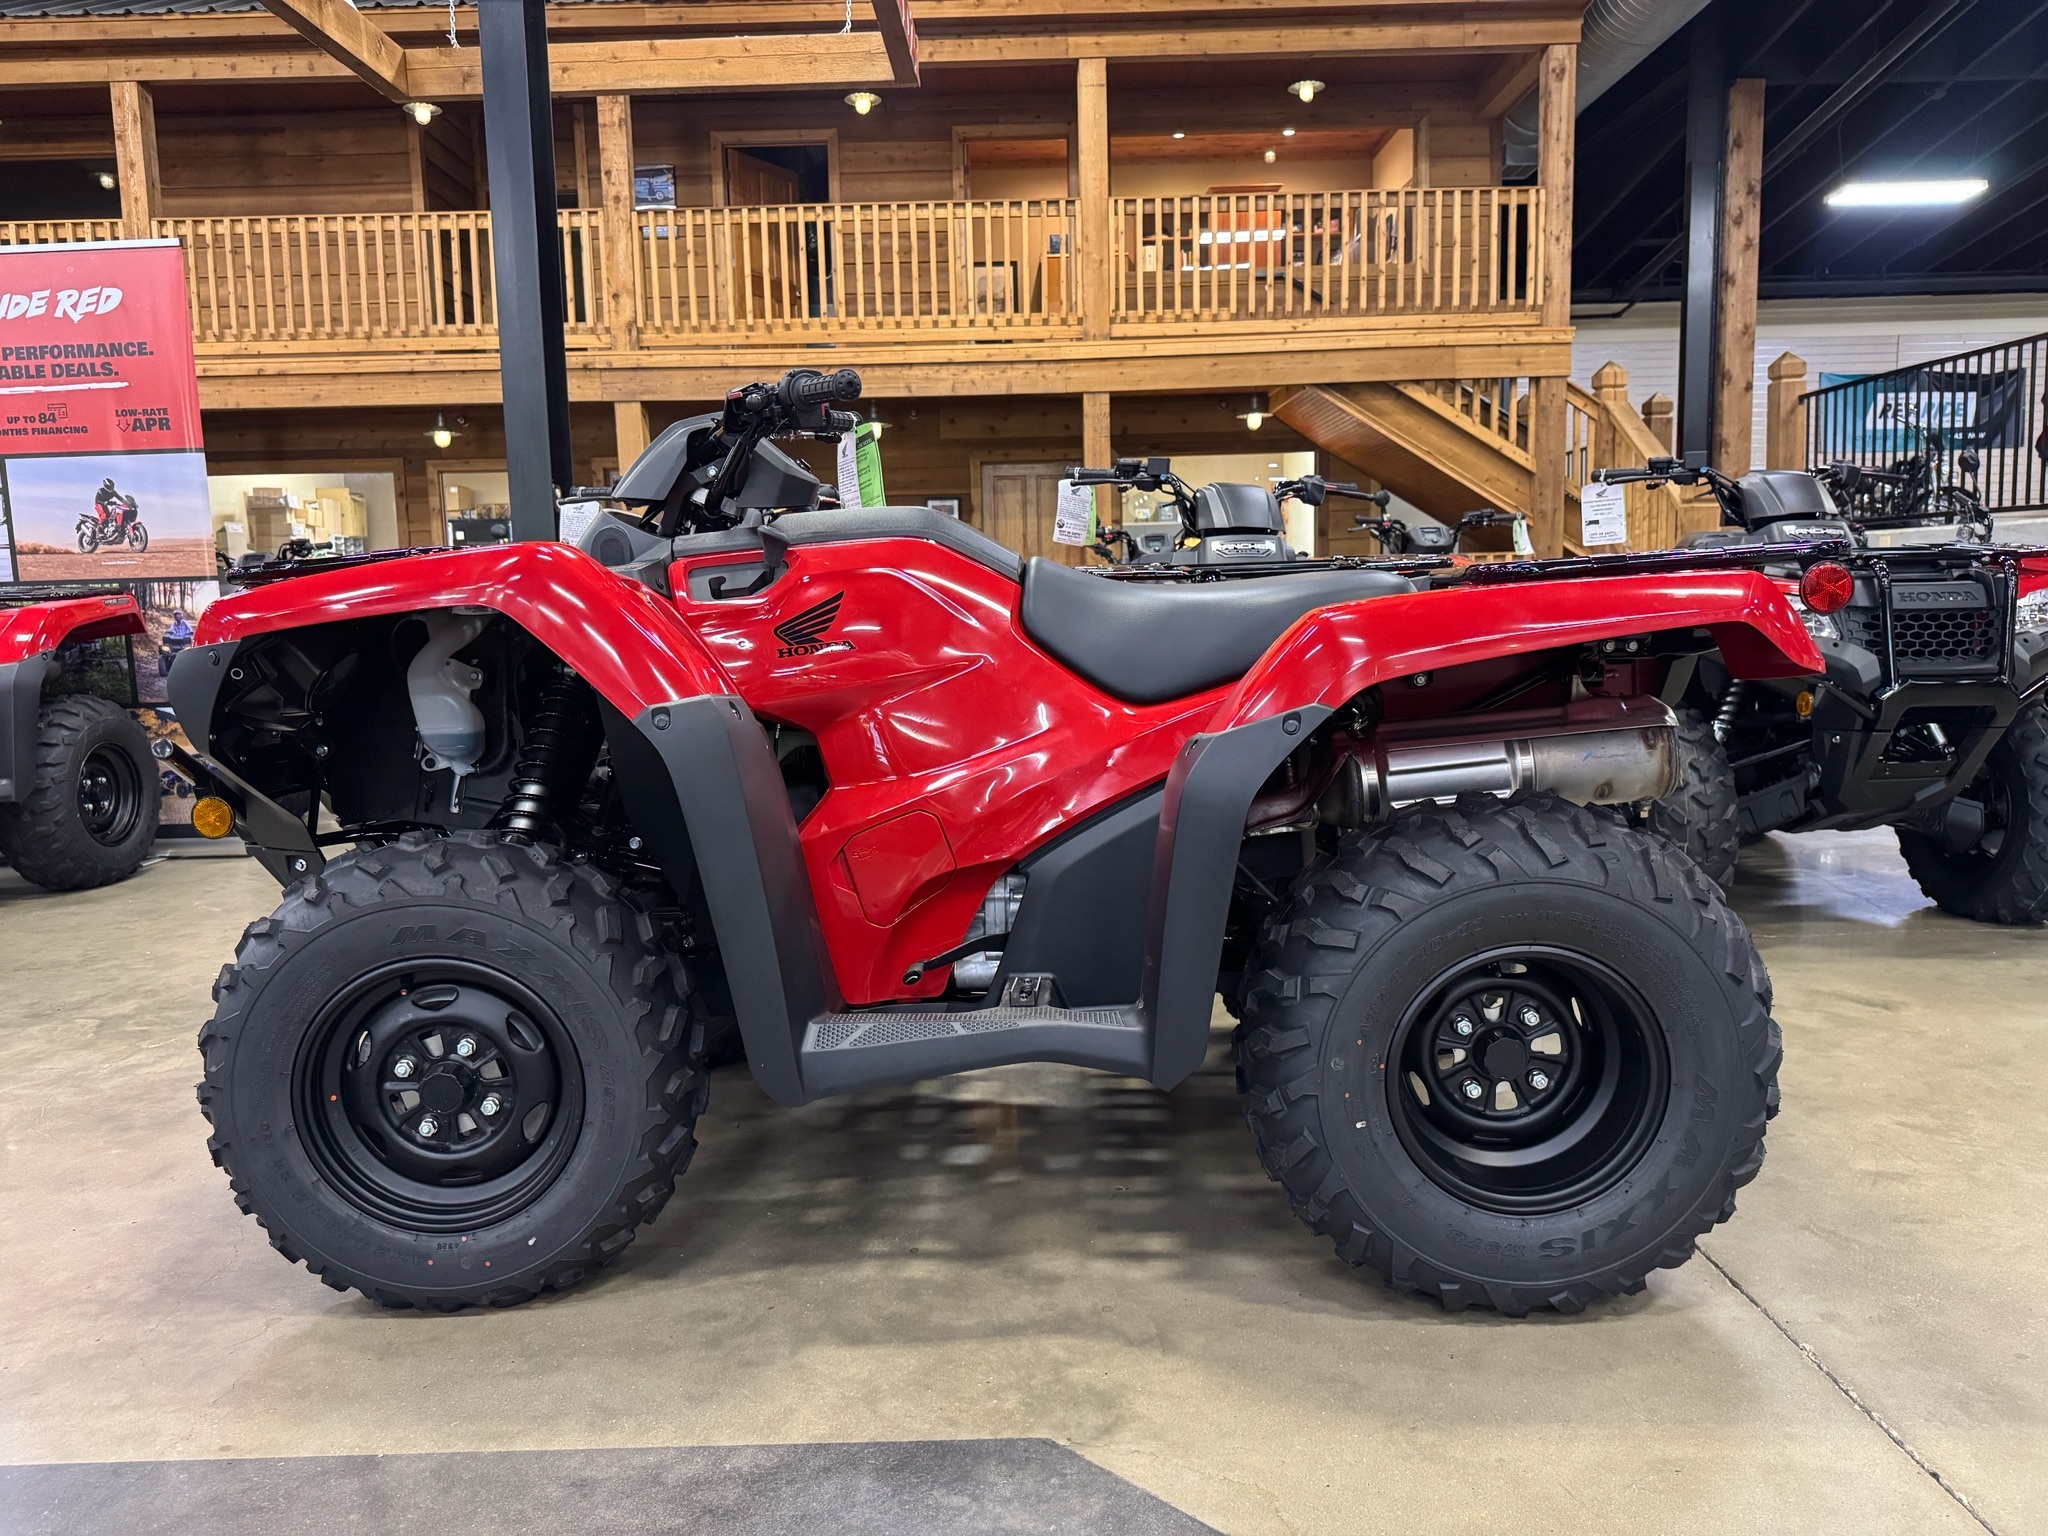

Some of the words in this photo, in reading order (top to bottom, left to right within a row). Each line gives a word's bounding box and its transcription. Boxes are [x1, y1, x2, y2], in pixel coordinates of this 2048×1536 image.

[54, 285, 123, 324] RED
[1, 341, 154, 361] PERFORMANCE.
[0, 364, 46, 380] ABLE
[51, 361, 119, 378] DEALS.
[6, 416, 20, 424] UP
[22, 415, 36, 424] TO
[38, 412, 57, 424] 84
[115, 407, 169, 417] LOW-RATE
[31, 425, 88, 435] FINANCING
[131, 417, 171, 432] APR
[1897, 590, 1979, 602] HONDA
[776, 640, 858, 659] HONDA
[388, 923, 610, 1051] MAXXIS
[1538, 1071, 1719, 1260] MAXXIS
